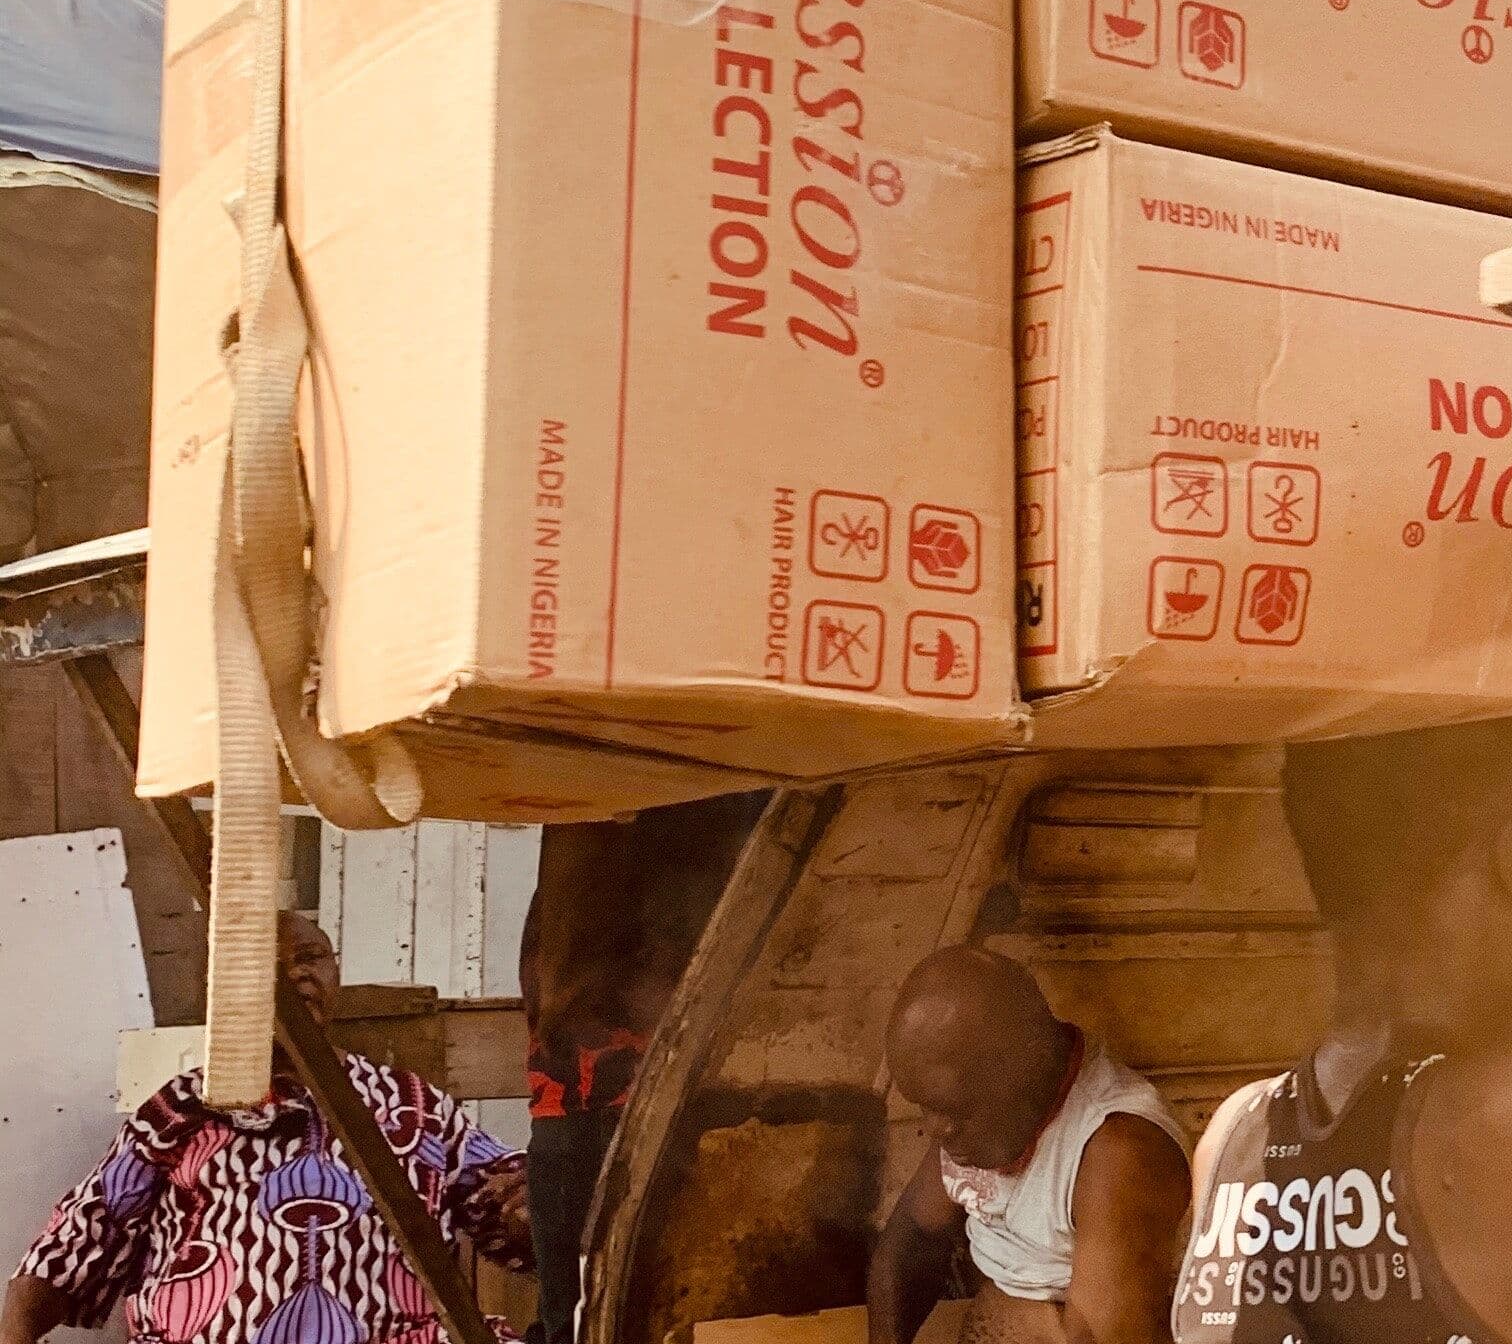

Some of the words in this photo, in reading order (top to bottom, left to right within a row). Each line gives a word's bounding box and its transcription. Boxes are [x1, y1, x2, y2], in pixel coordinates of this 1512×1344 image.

[1140, 197, 1241, 235] NIGERIA
[1244, 213, 1270, 239] IN
[1275, 218, 1341, 253] MADE
[1150, 414, 1263, 447] PRODUCT
[1269, 425, 1321, 451] HAIR
[535, 418, 568, 510] MADE
[536, 518, 563, 548] IN
[772, 486, 795, 545] HAIR
[526, 557, 562, 681] NIGERIA
[762, 548, 794, 684] PRODUCT
